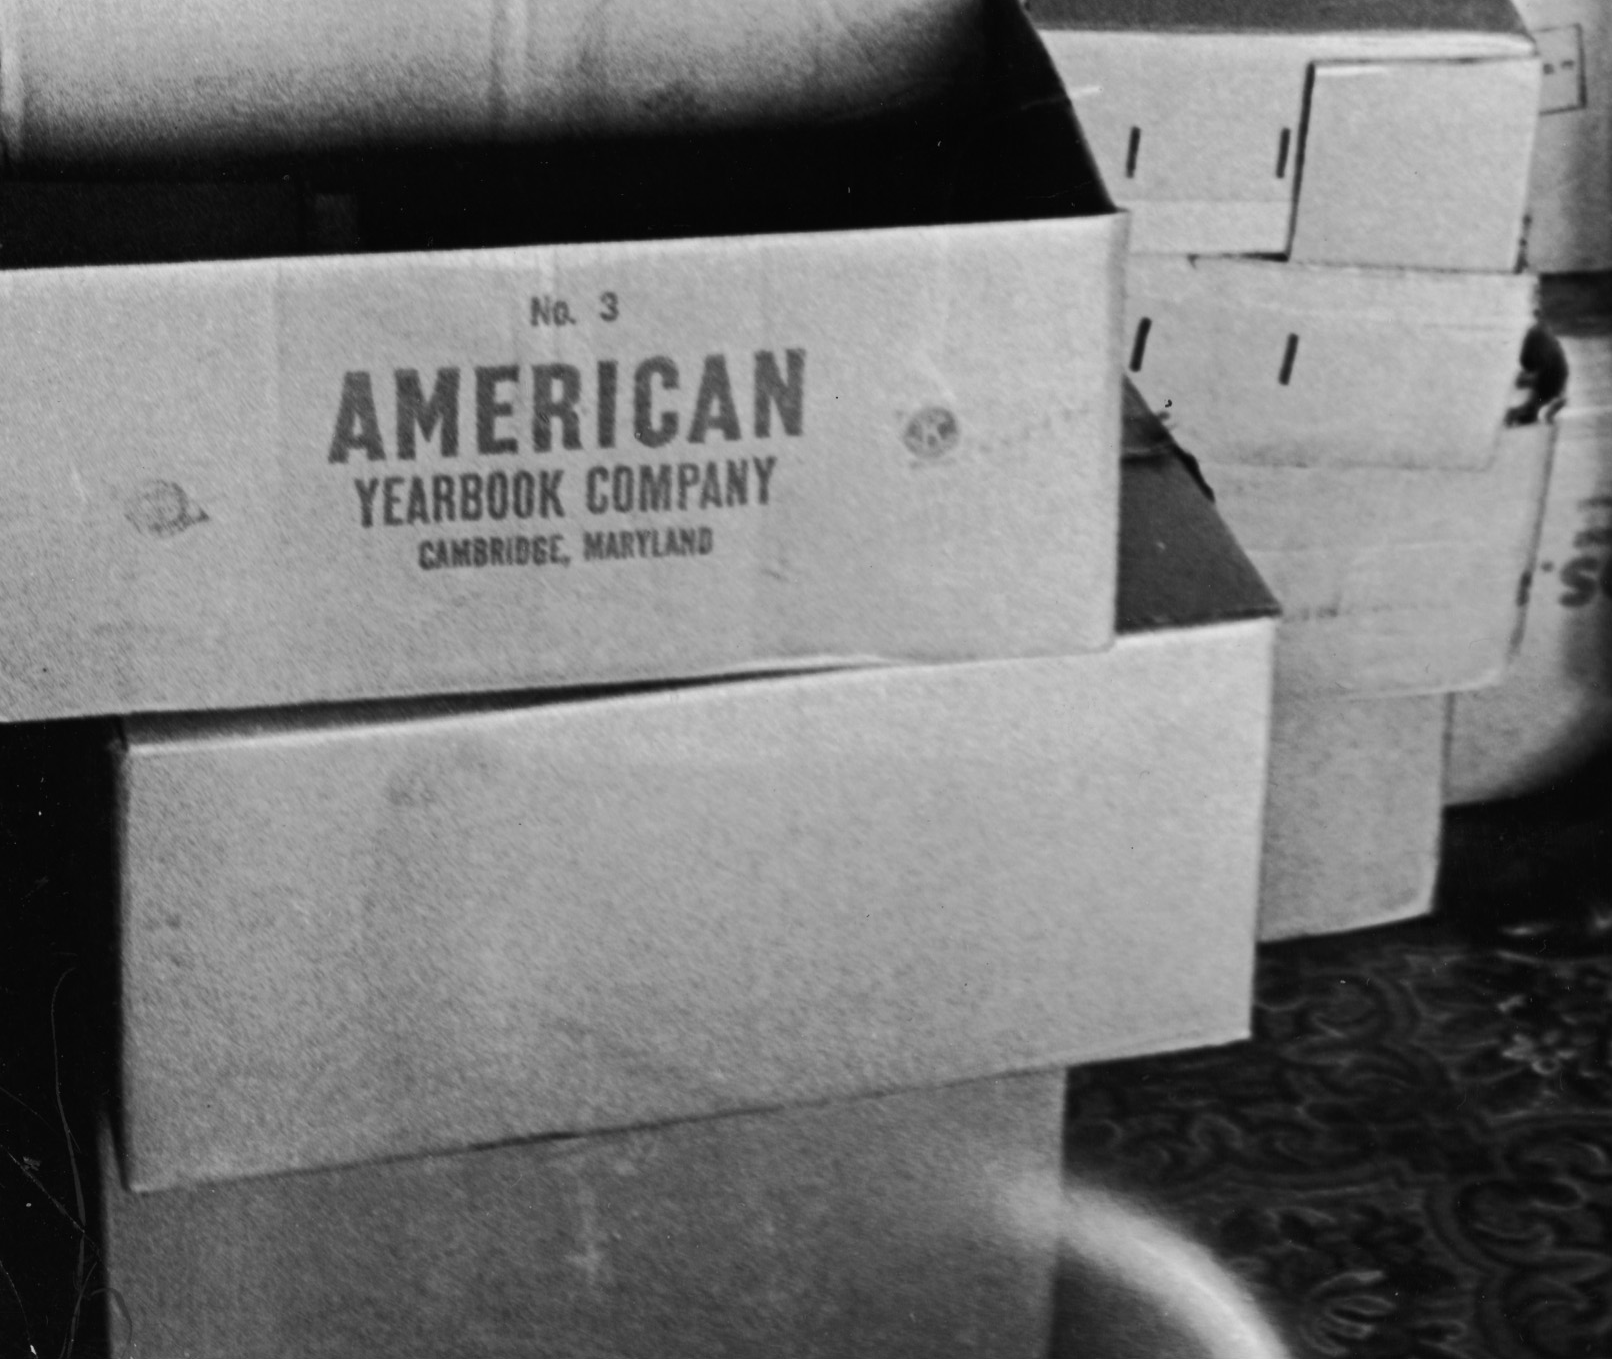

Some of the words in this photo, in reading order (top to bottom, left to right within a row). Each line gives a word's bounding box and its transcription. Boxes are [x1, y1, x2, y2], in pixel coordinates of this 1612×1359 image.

[530, 295, 577, 326] No.
[599, 292, 620, 322] 3
[328, 347, 807, 464] AMERICAN
[355, 469, 566, 528] YEARBOOK
[585, 455, 778, 517] COMPANY
[418, 533, 572, 571] CAMBRIDGE,
[583, 526, 713, 563] MARYLAND
